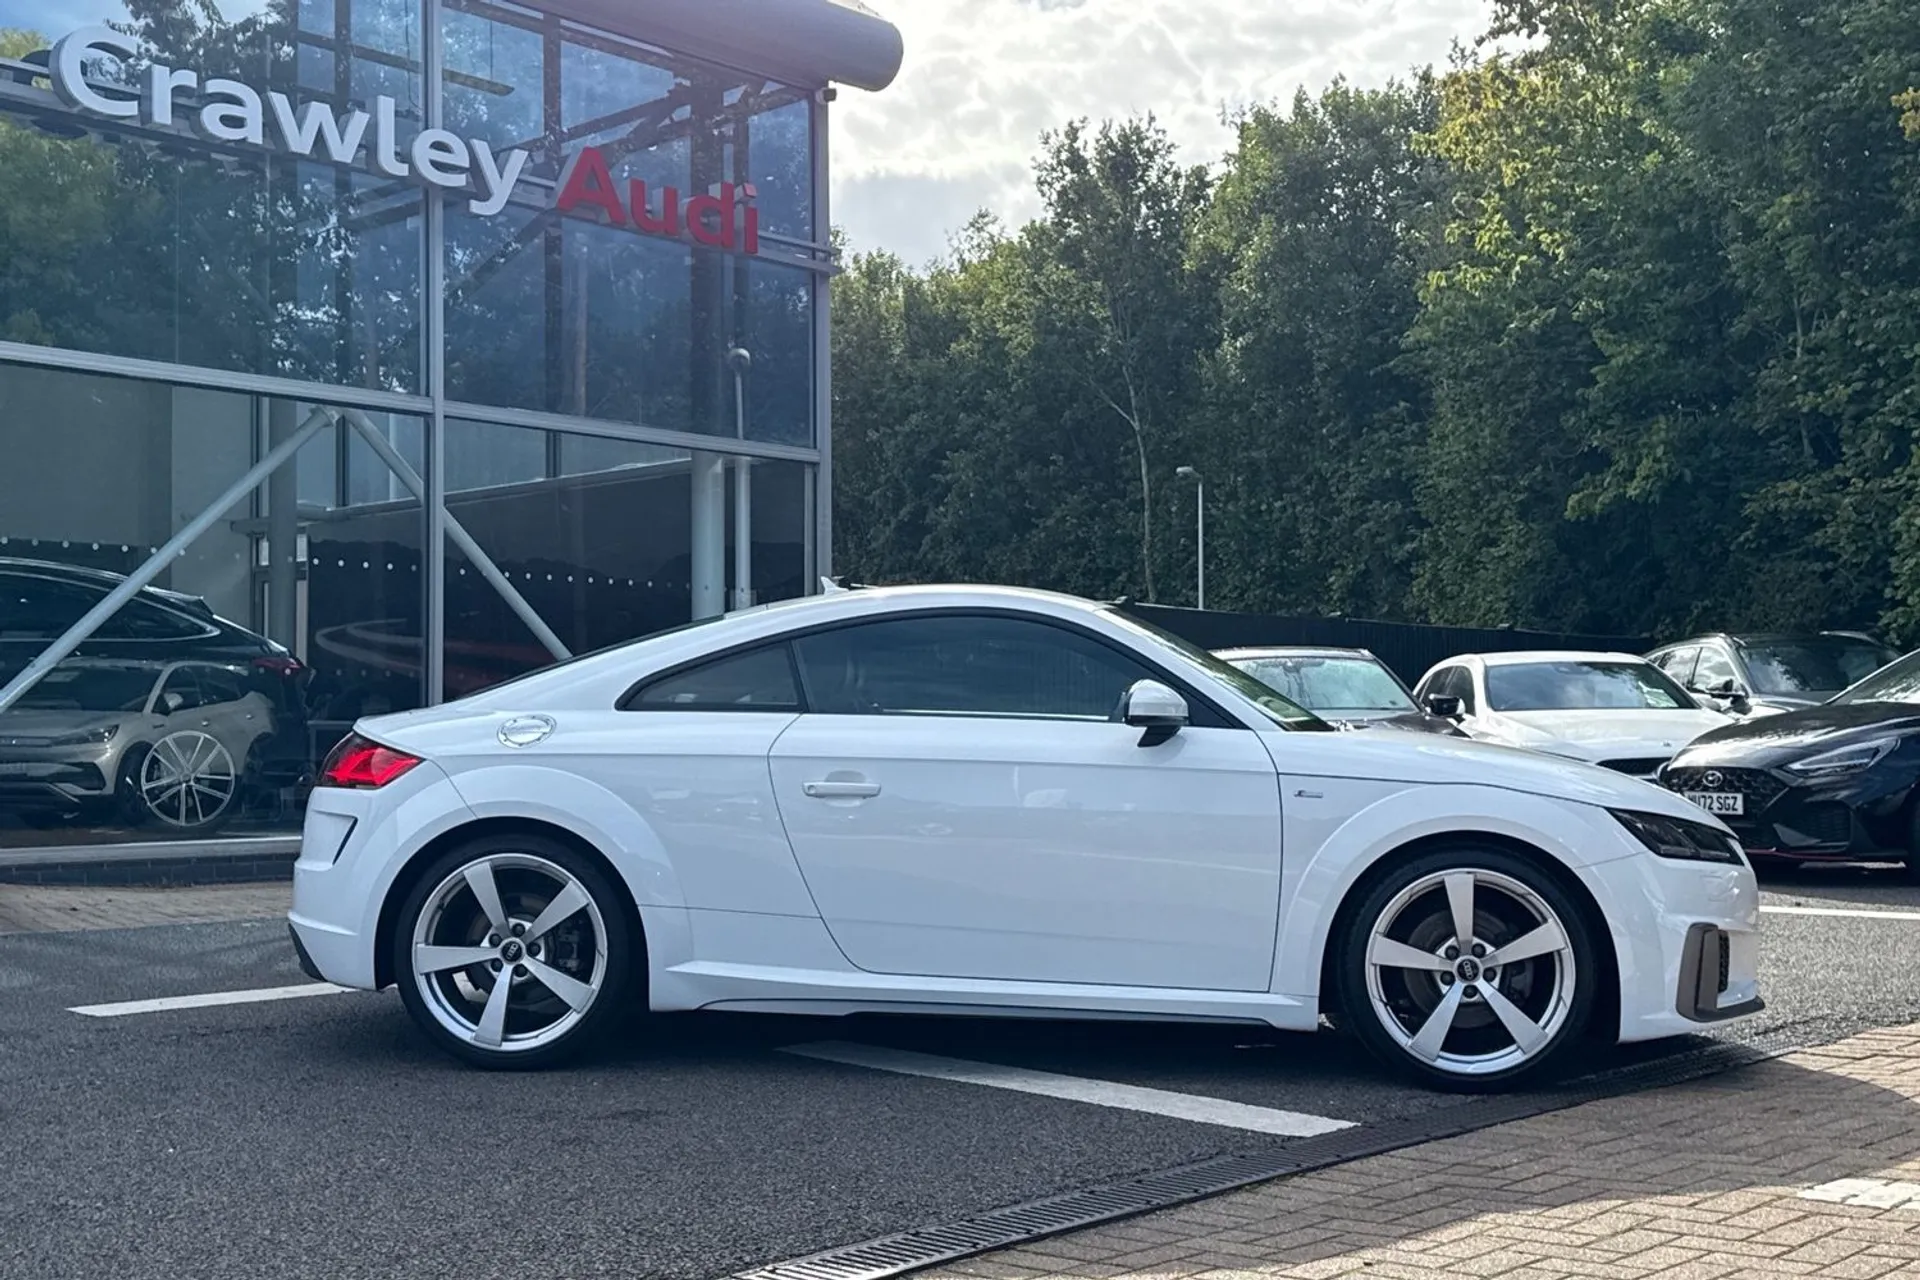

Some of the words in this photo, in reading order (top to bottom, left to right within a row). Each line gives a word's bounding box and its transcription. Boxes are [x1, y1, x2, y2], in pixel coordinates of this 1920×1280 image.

[51, 25, 529, 216] Crawley
[556, 146, 759, 254] Audi
[1716, 795, 1738, 812] SGZ
